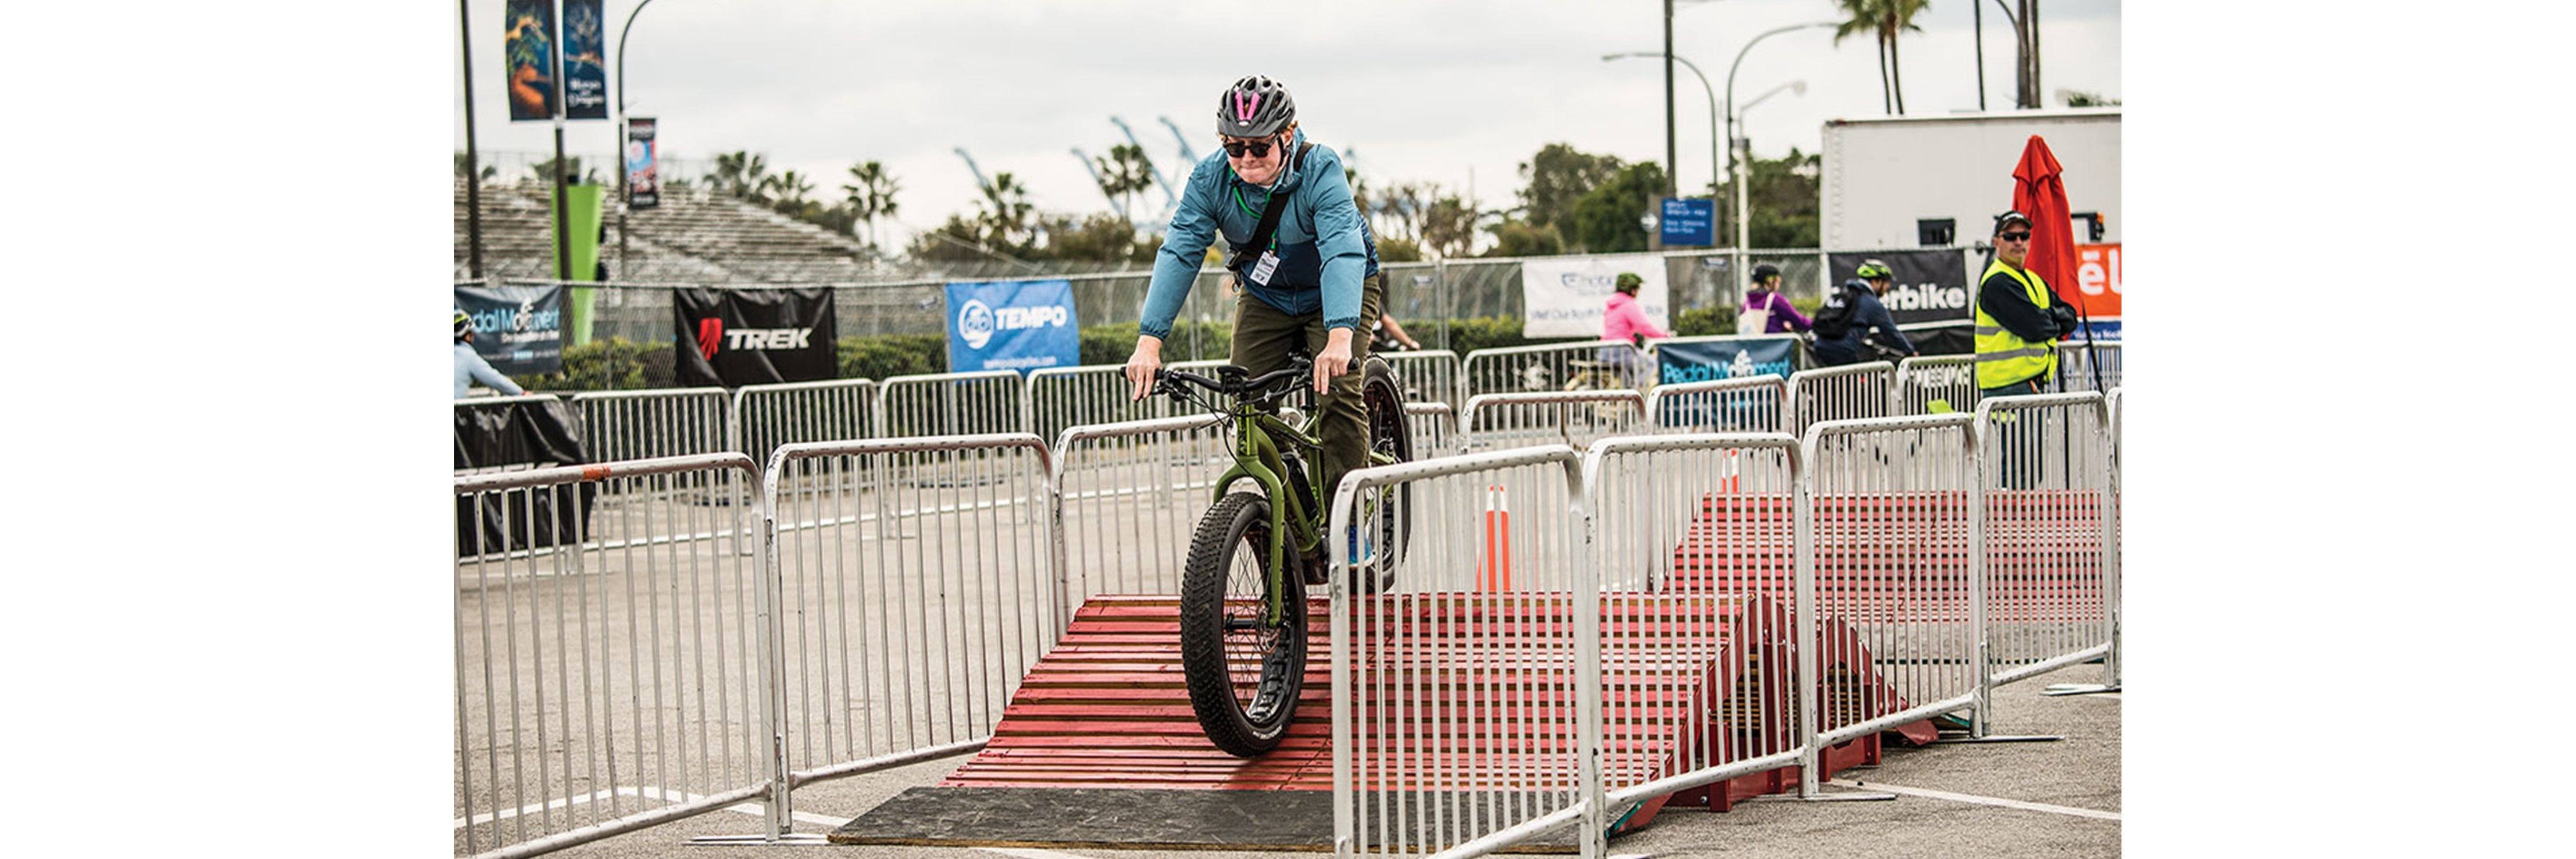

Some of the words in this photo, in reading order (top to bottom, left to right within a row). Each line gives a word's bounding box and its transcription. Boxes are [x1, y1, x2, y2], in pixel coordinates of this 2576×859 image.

[995, 305, 1067, 330] TEMPO
[725, 328, 813, 350] TREK
[1664, 361, 1710, 384] Pedal
